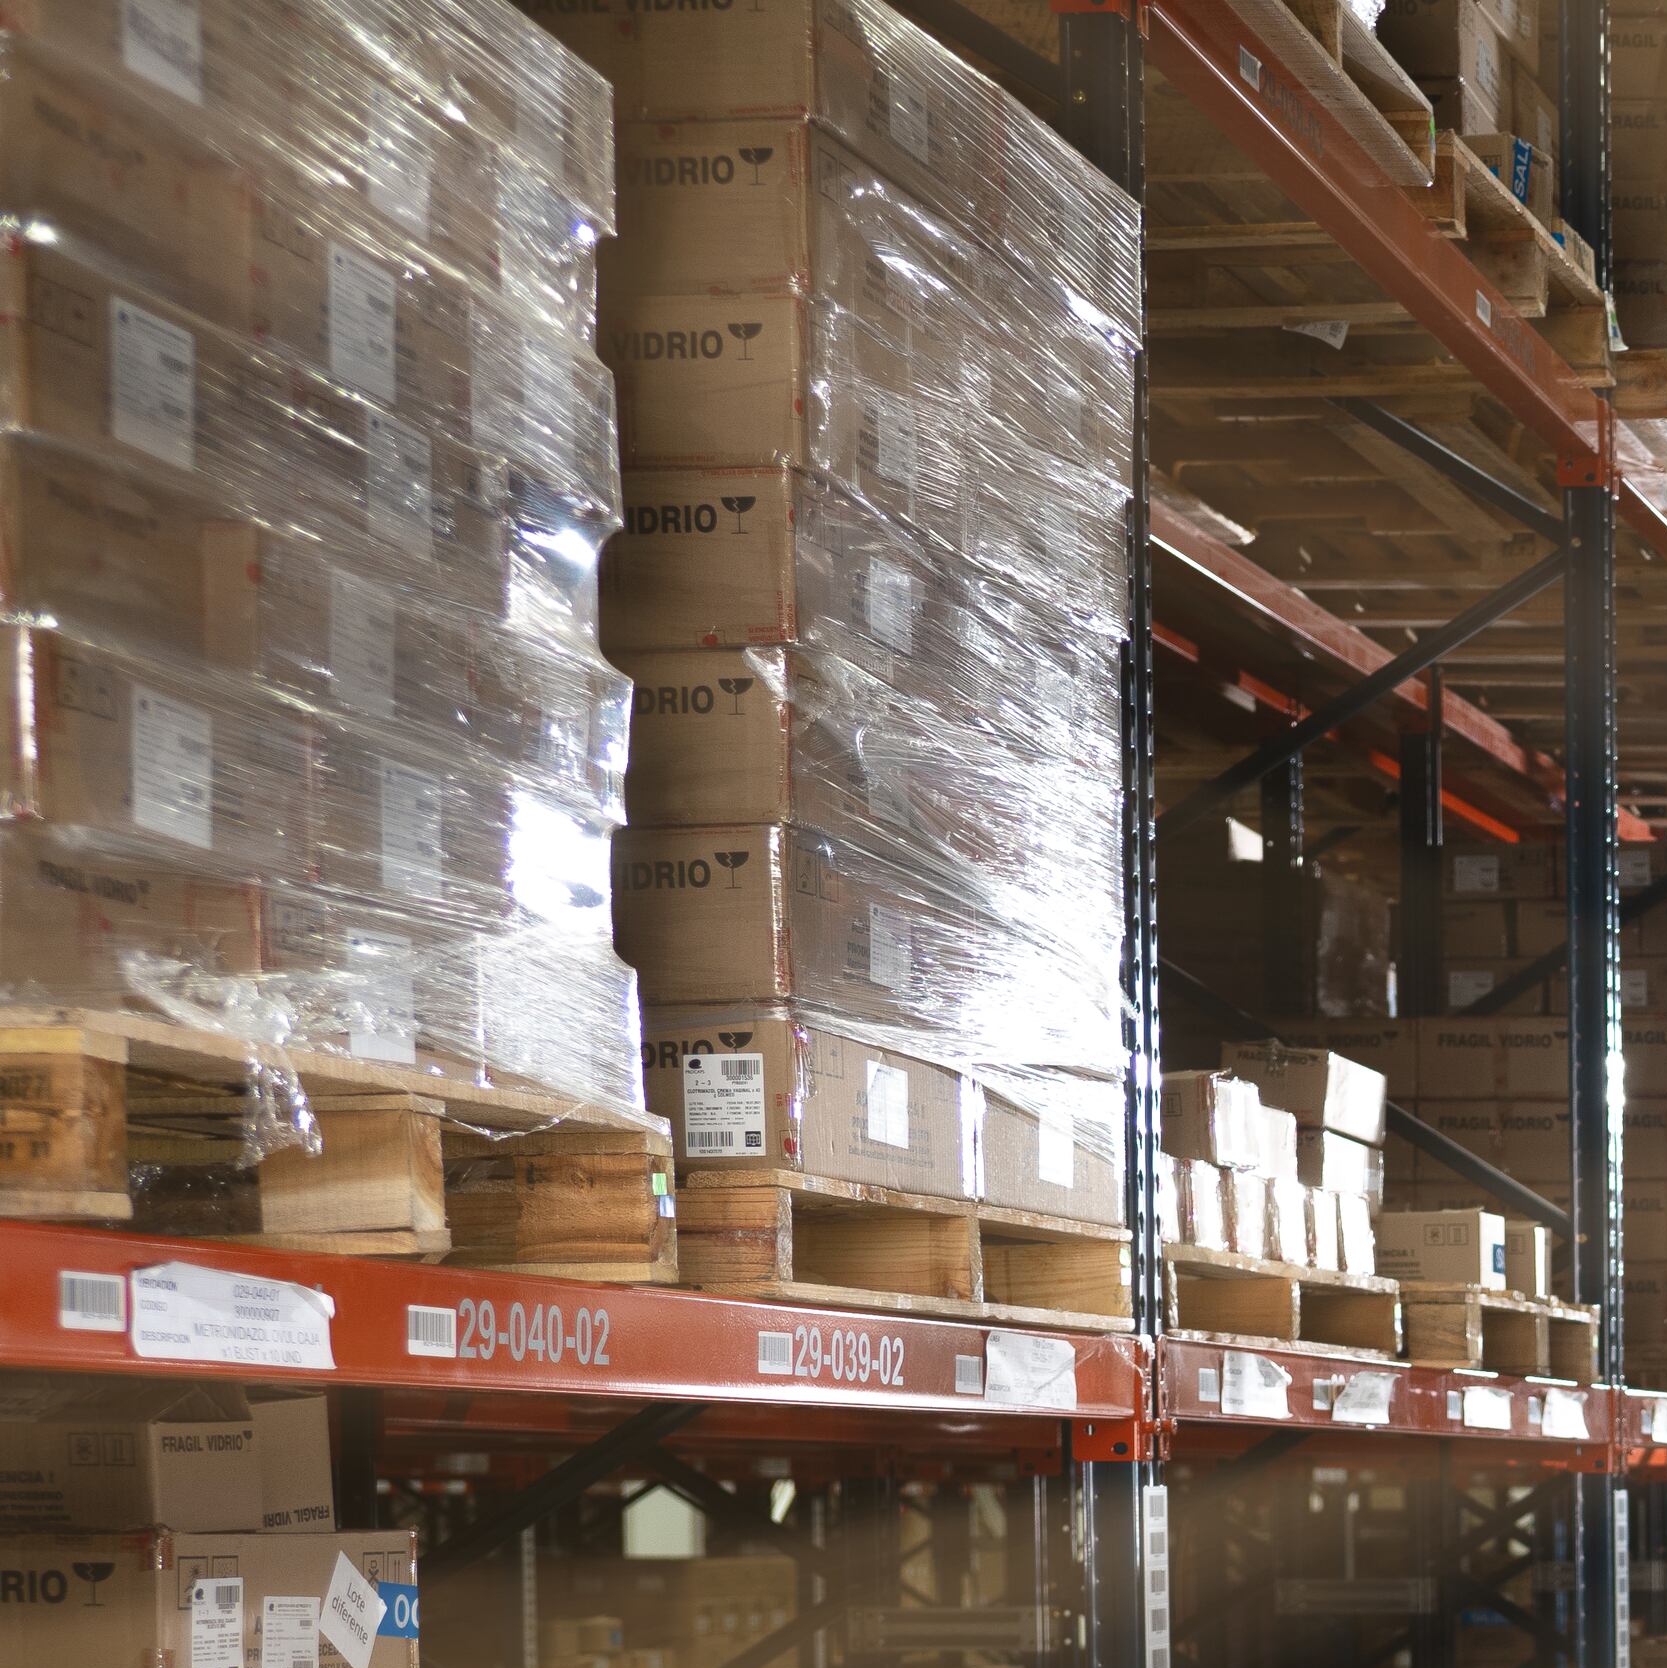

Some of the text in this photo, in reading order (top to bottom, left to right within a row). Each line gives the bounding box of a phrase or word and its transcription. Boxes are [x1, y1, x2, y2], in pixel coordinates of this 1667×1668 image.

[627, 504, 718, 535] IDRIO
[622, 858, 712, 892] IDRIO
[1438, 1032, 1552, 1049] FRAGIL VIDRIO
[1438, 1114, 1494, 1131] FRAGIL
[458, 1297, 611, 1366] 29-040-02
[794, 1324, 905, 1387] 29-039-02
[162, 1432, 244, 1454] FRAGIL VIDRIO
[347, 1582, 366, 1613] Lote
[331, 1595, 370, 1645] diferente
